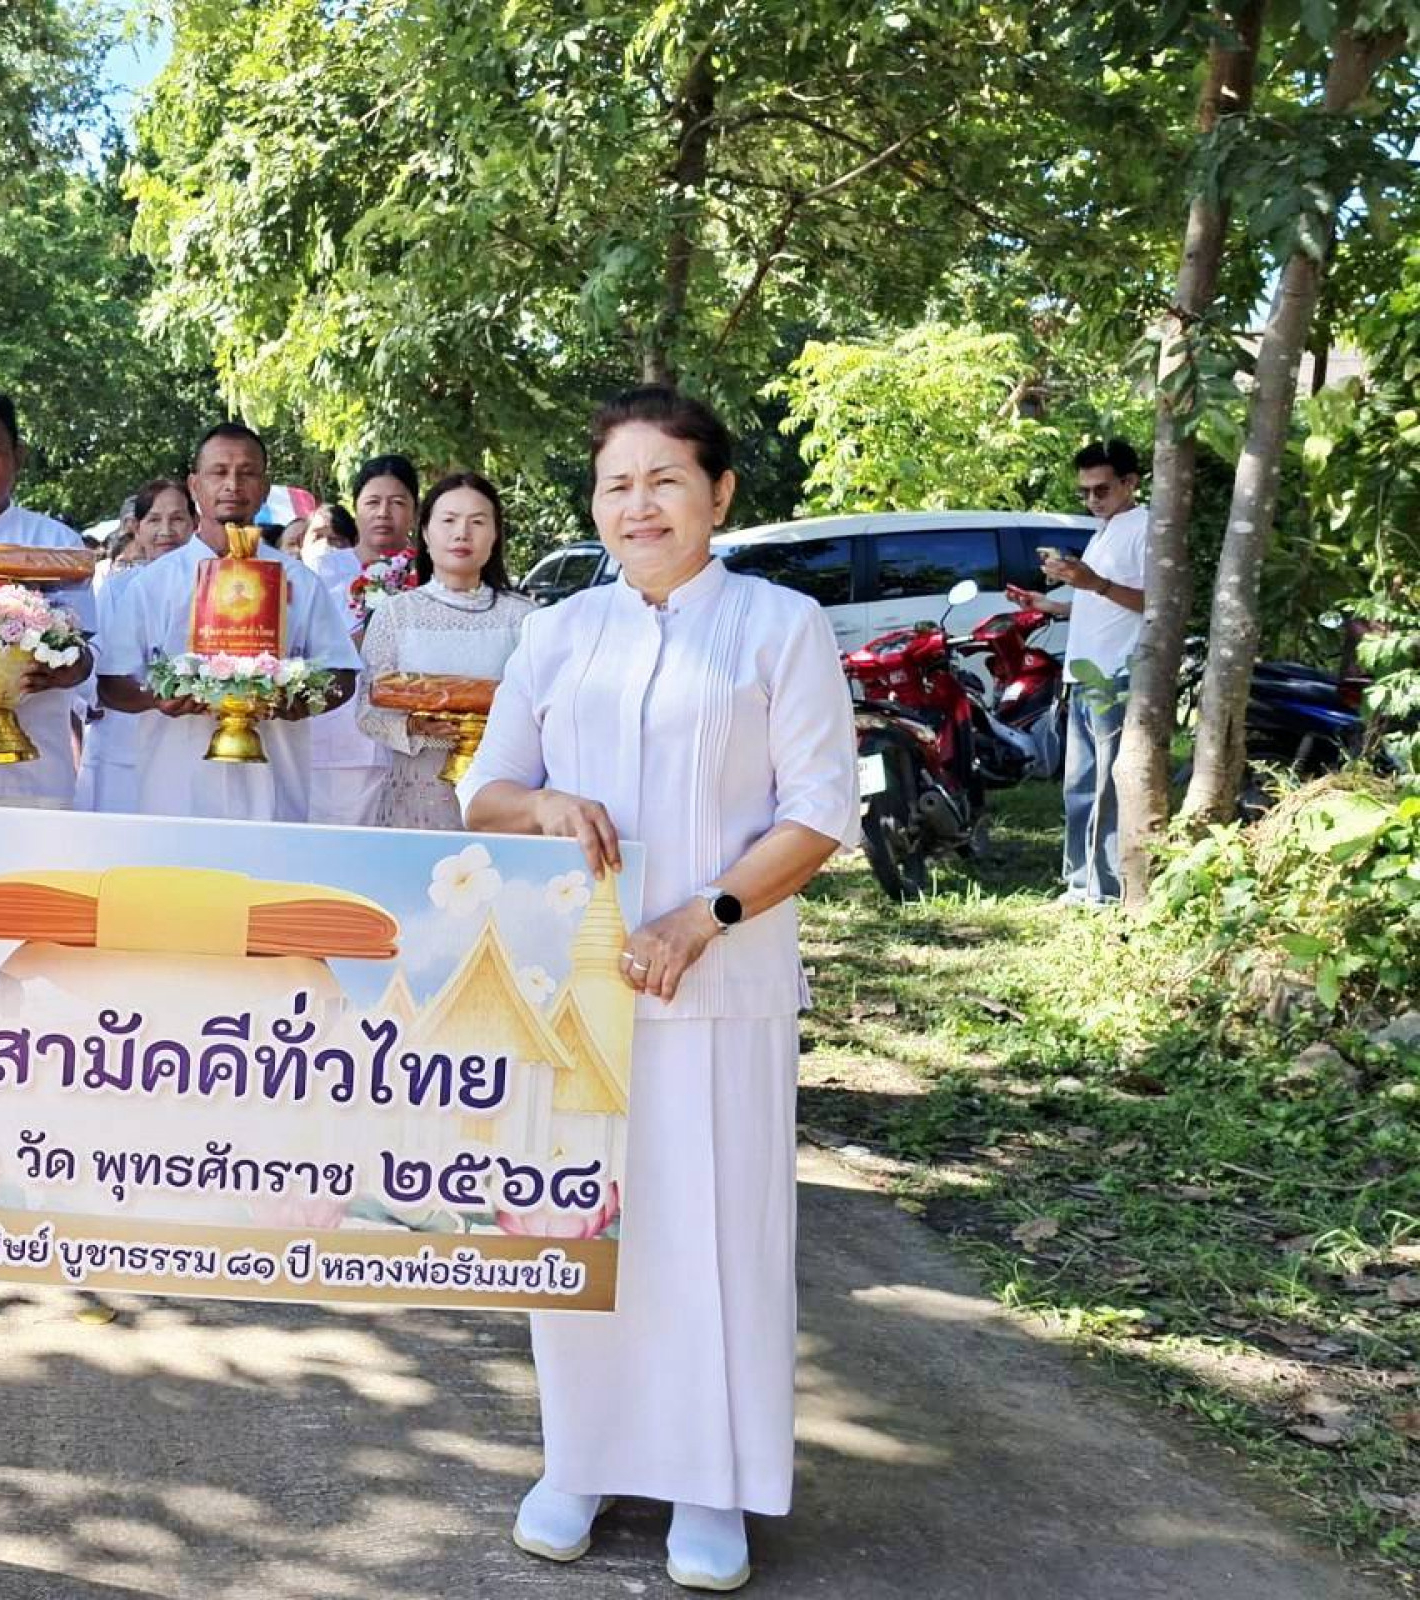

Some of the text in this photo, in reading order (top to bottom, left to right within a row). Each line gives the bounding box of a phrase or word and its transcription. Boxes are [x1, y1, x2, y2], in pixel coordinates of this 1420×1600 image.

[17, 1129, 75, 1180] วัด
[92, 1141, 355, 1201] พุทธศักราช
[380, 1149, 602, 1209] ๒๕๖๘
[60, 1239, 215, 1279] บูชาธรรม
[227, 1250, 275, 1277] ๘๑
[287, 1242, 312, 1279] ปี
[322, 1249, 581, 1291] หลวงพ่อธัมมชโย
